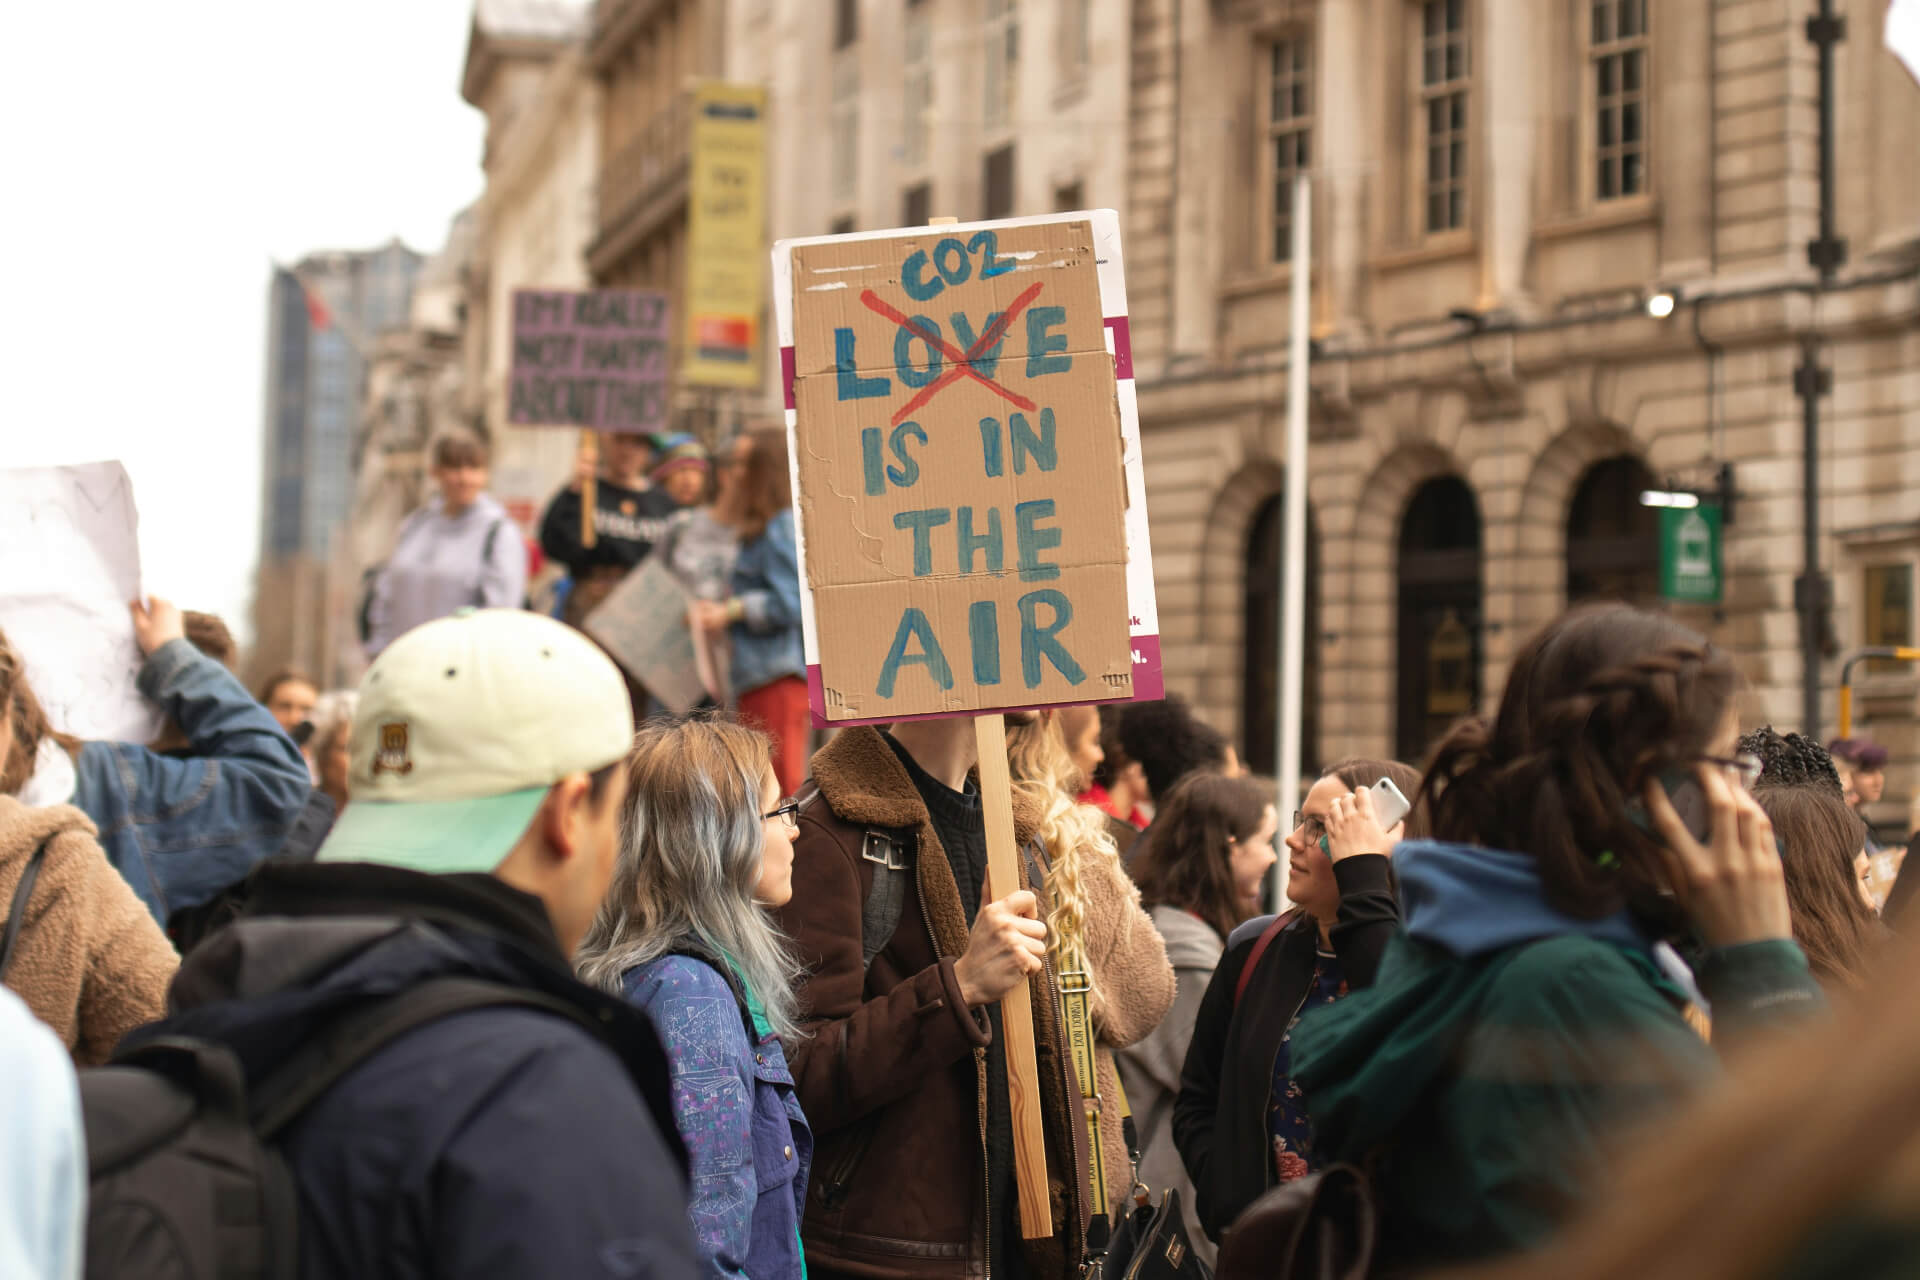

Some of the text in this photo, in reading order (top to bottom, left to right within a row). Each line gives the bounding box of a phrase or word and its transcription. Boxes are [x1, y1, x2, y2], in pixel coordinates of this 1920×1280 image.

[901, 230, 1016, 301] CO2
[573, 293, 667, 329] REALLY
[515, 332, 668, 373] NOT HAPPY
[835, 307, 1072, 401] LOVE
[511, 376, 667, 425] ABOUT THIS
[862, 408, 1057, 495] IS IN
[893, 499, 1062, 582] THE
[875, 589, 1086, 699] AIR
